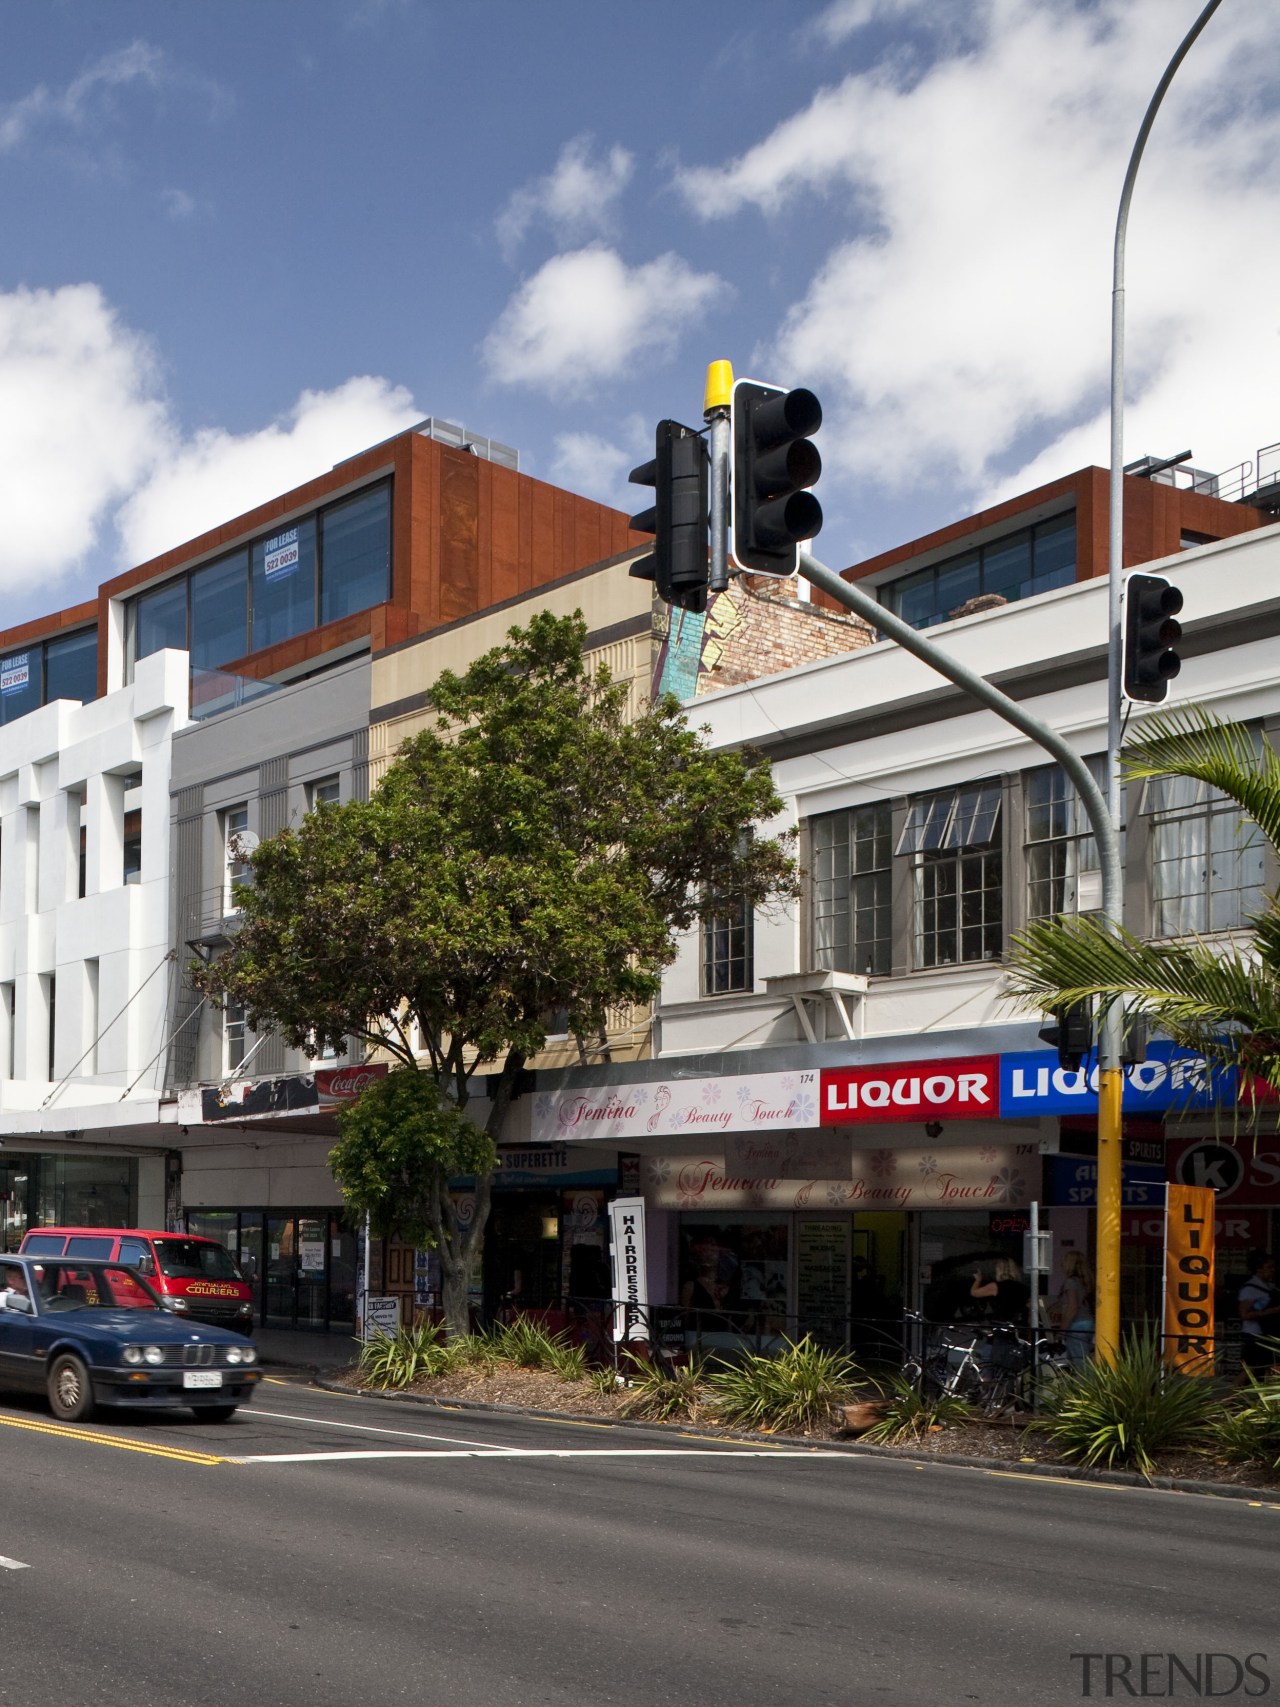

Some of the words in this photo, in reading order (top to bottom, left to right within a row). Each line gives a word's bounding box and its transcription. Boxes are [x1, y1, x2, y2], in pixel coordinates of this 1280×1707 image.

[266, 538, 278, 552] FOR
[278, 528, 297, 547] LEASE
[266, 557, 279, 571] 522
[280, 550, 297, 565] 0039
[1, 659, 12, 671] FOR
[12, 653, 28, 667] LEASE
[800, 1074, 814, 1083] 174
[827, 1073, 991, 1111] LIQUOR
[1012, 1058, 1209, 1098] LIQOR
[559, 1096, 639, 1127] Femina
[680, 1106, 734, 1129] Beauty
[740, 1099, 796, 1121] Touch
[1016, 1144, 1033, 1155] 174
[1129, 1141, 1162, 1160] SPIRITS
[506, 1152, 567, 1168] SUPERETTE
[846, 1178, 913, 1208] Beauty
[924, 1170, 1000, 1201] Touch
[1177, 1204, 1210, 1354] LIQUOR
[186, 1286, 239, 1296] COURIERS
